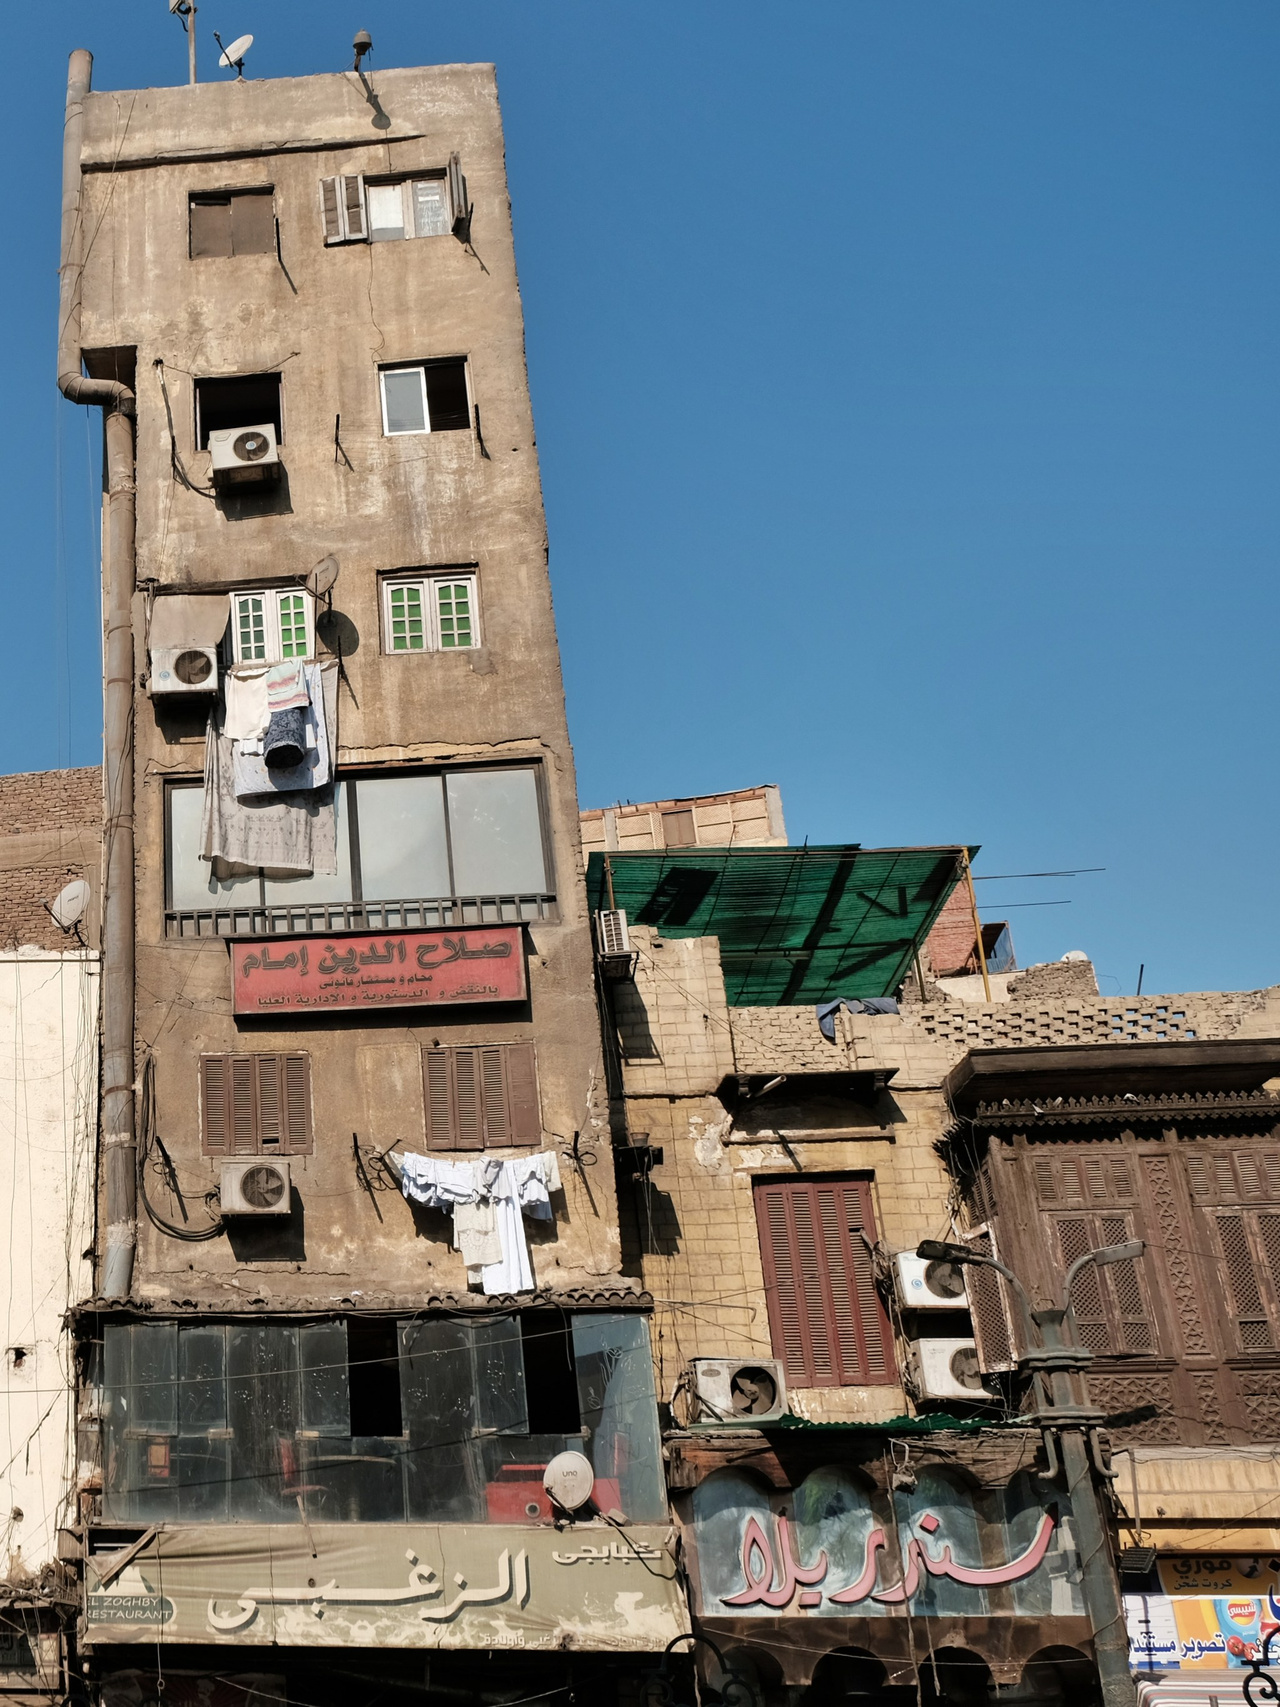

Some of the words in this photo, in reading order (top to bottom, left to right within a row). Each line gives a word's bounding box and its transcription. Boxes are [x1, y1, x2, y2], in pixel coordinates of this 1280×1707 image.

[318, 939, 406, 975] الدين
[416, 935, 512, 969] صلاح
[242, 944, 308, 978] إمام
[356, 975, 396, 988] مستشار
[399, 975, 405, 986] و
[407, 973, 433, 985] محام
[362, 988, 429, 1003] الدستورية
[439, 990, 445, 999] و
[449, 984, 499, 999] بالنقض
[258, 996, 290, 1008] العليا
[351, 994, 357, 1004] و
[718, 1501, 1059, 1607] سندريلا
[1174, 1578, 1199, 1590] شحن
[1202, 1579, 1232, 1589] كروت
[103, 1596, 160, 1607] ZOGHBY
[1181, 1633, 1226, 1659] تصوير
